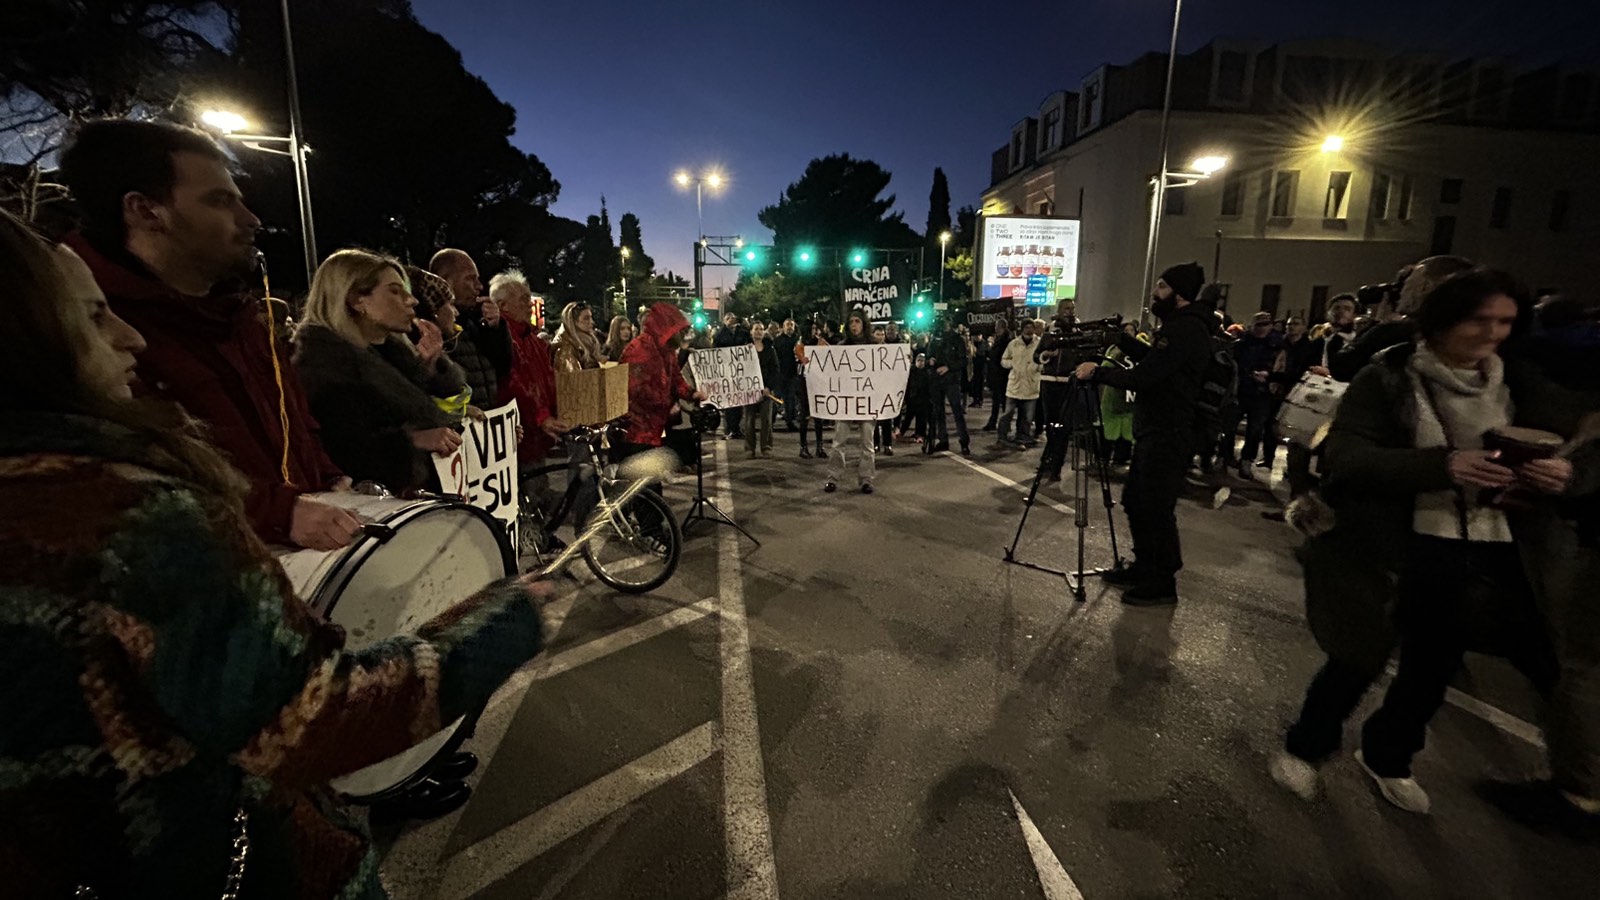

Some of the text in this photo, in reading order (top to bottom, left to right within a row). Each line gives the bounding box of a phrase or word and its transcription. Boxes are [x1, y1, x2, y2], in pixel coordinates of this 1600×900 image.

[852, 265, 890, 283] CRNA
[845, 285, 898, 303] NAPAĆENA
[693, 346, 753, 365] DAJTE NAM
[808, 346, 907, 374] MASIRA
[729, 362, 744, 378] DA
[829, 377, 874, 392] LI TA
